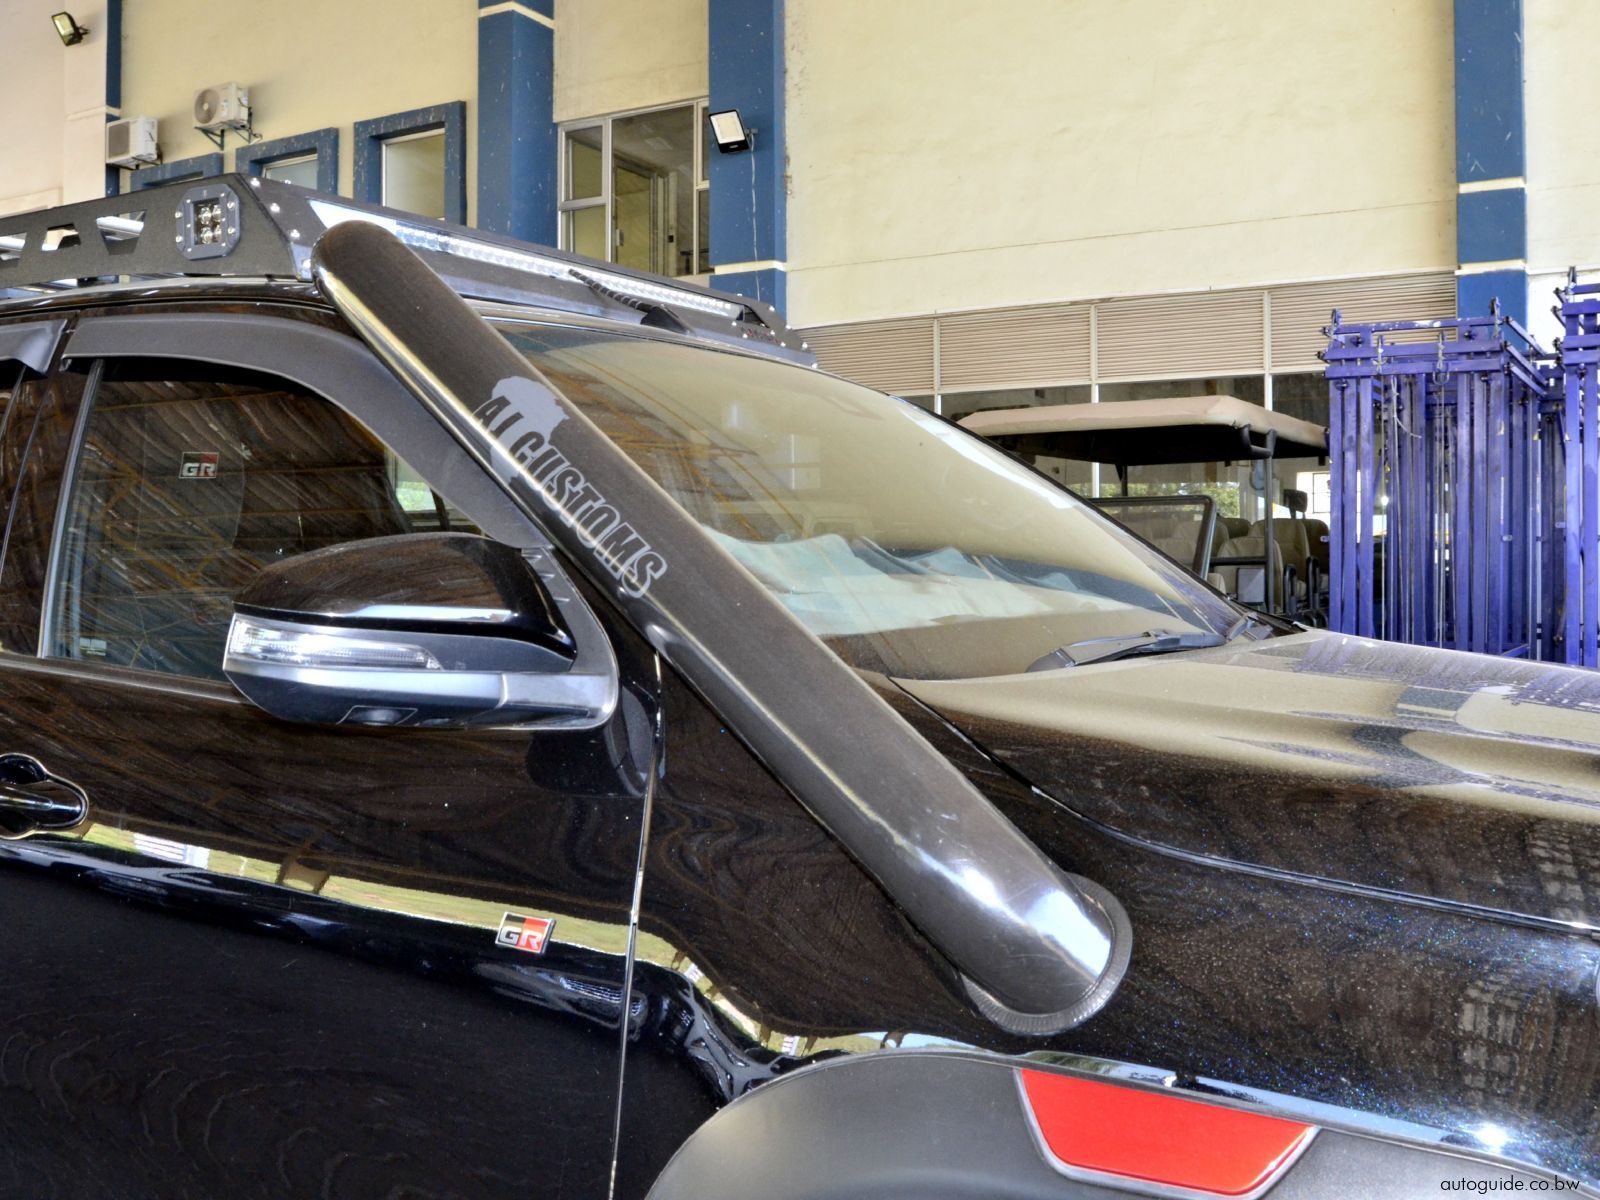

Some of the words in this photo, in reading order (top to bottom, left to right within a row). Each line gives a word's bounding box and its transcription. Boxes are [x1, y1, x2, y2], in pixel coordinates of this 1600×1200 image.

[181, 462, 217, 477] GR
[508, 430, 668, 598] CUSTOMS
[499, 925, 543, 951] GR
